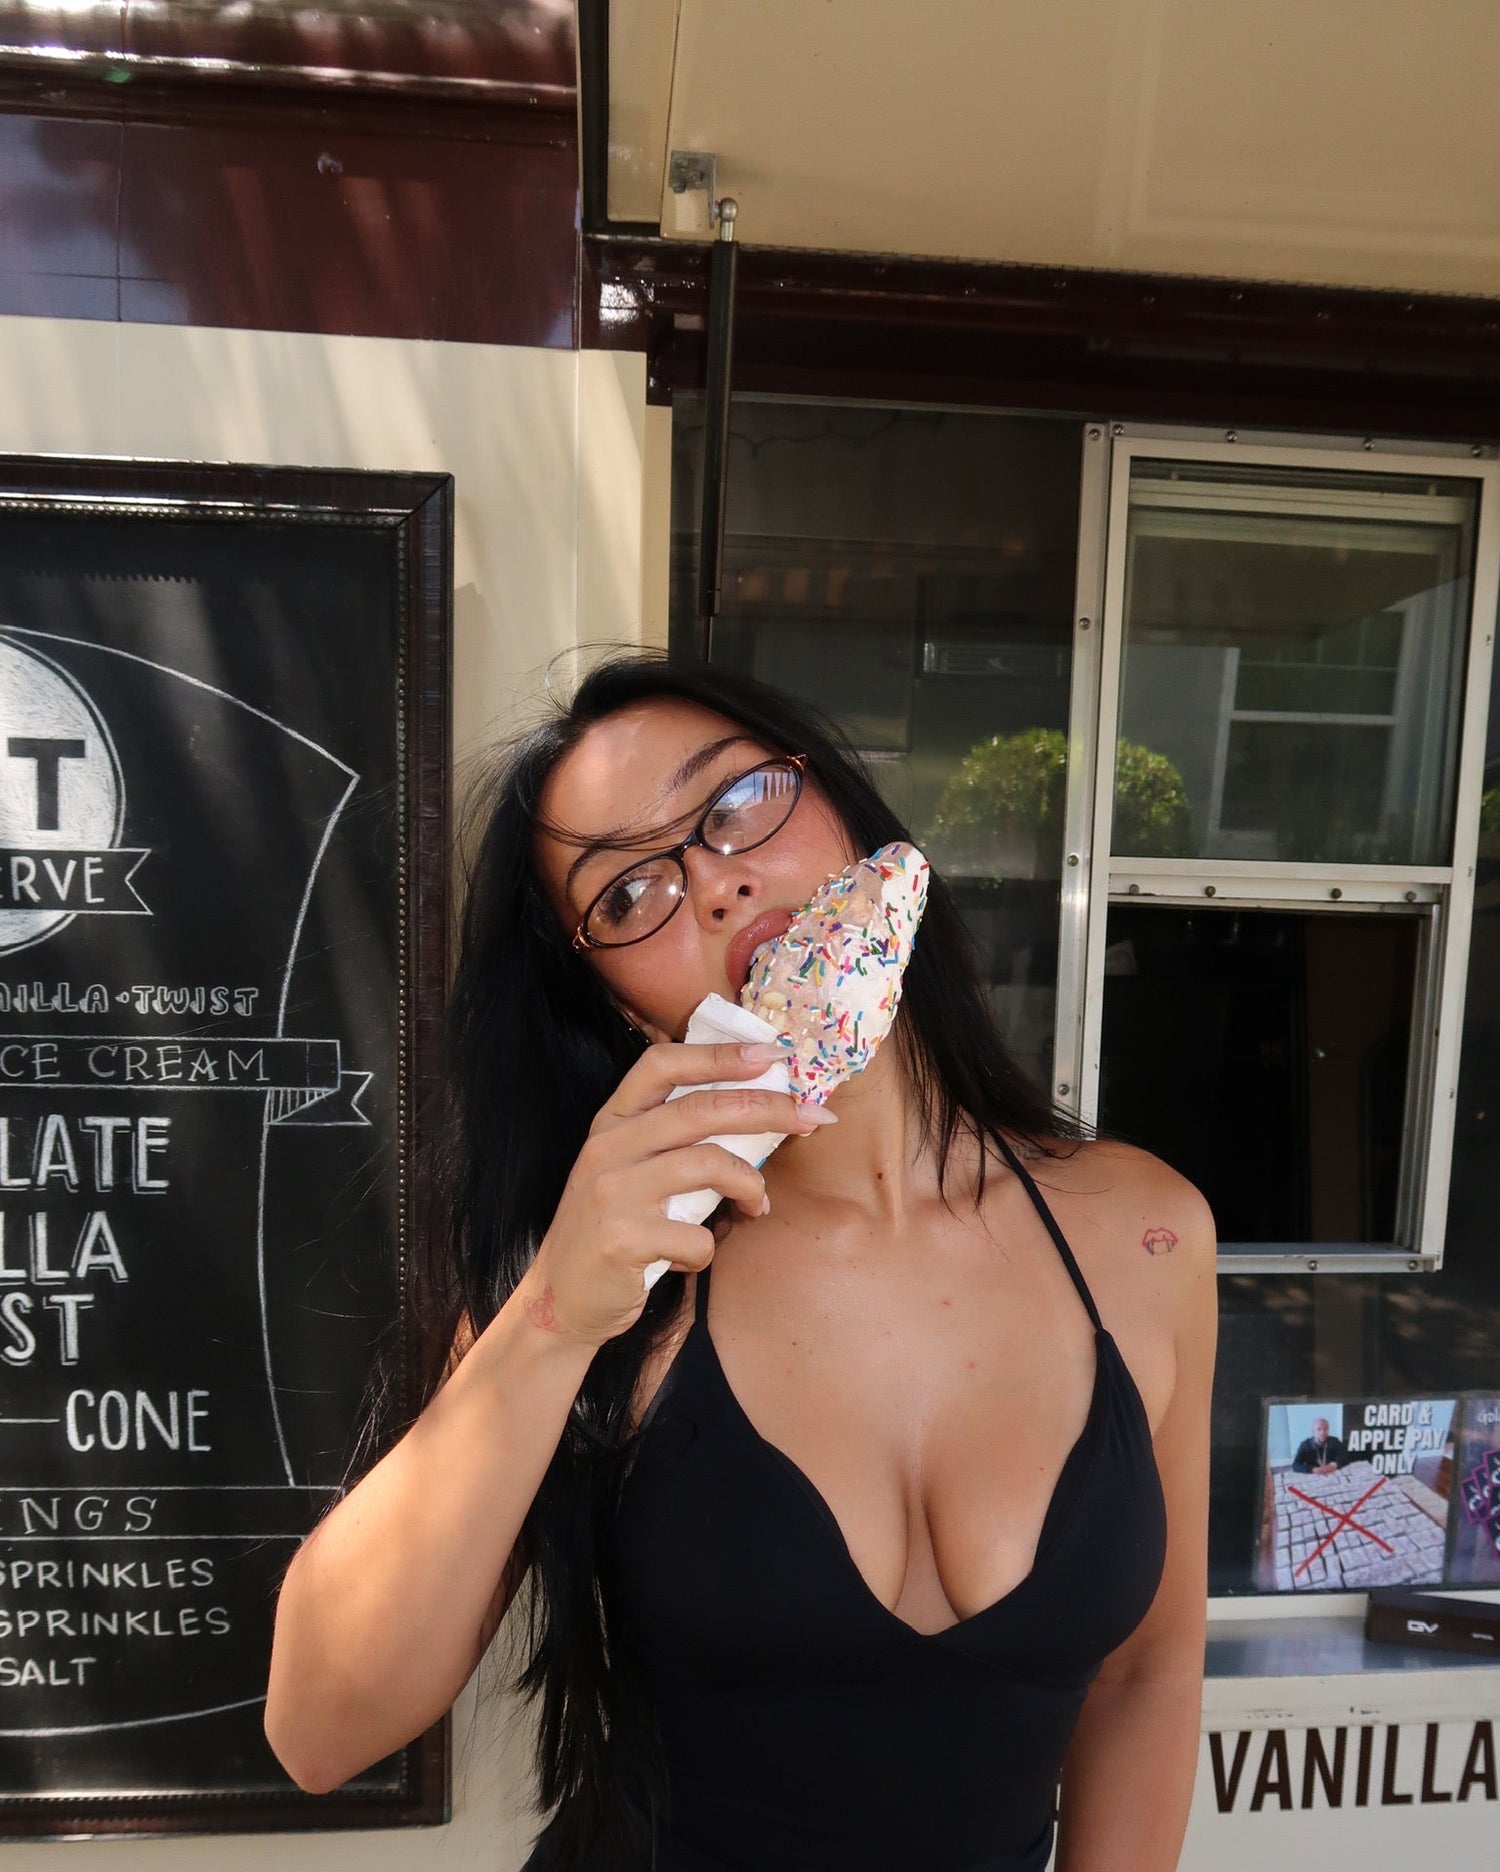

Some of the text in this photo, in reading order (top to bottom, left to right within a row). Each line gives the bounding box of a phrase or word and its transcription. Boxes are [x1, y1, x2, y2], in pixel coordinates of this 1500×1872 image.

[0, 856, 105, 905] RVE
[131, 985, 260, 1017] TWIST
[0, 1043, 271, 1082] CE CREAM
[0, 1113, 172, 1194] LATE
[0, 1292, 95, 1367] ST
[66, 1388, 213, 1453] CONE
[1363, 1402, 1433, 1427] CARD &
[1347, 1428, 1445, 1452] APPLE PAY
[1371, 1453, 1416, 1475] ONLY
[0, 1496, 157, 1535] NGS
[0, 1558, 215, 1590] PRINKLES
[0, 1656, 97, 1687] SALT
[1208, 1719, 1499, 1813] VANILLA
